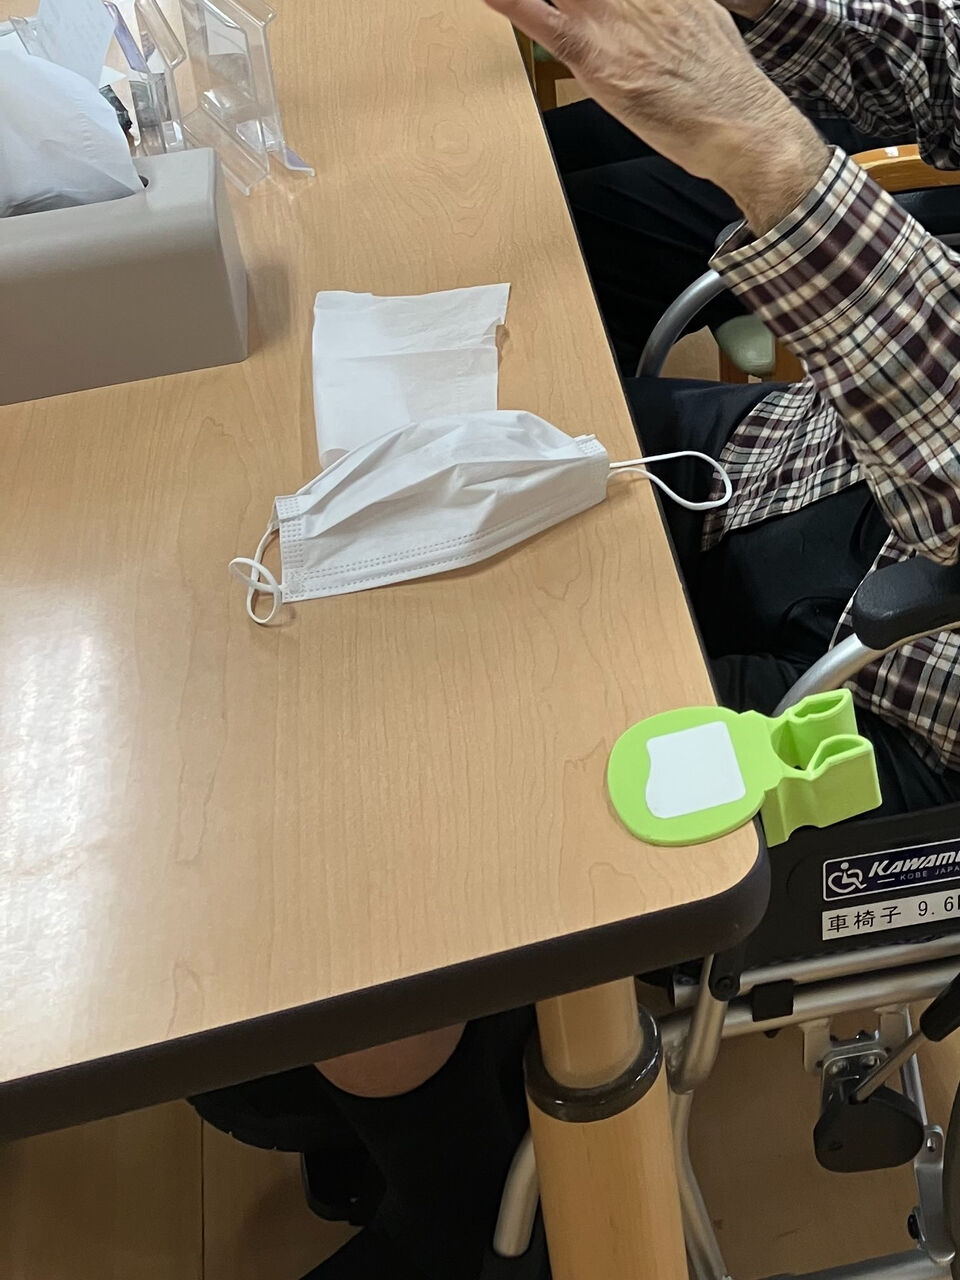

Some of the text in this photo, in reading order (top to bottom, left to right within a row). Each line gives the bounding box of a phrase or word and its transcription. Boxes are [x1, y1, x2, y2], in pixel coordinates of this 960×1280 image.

[900, 870, 928, 881] KOBE
[826, 905, 902, 933] 車椅子
